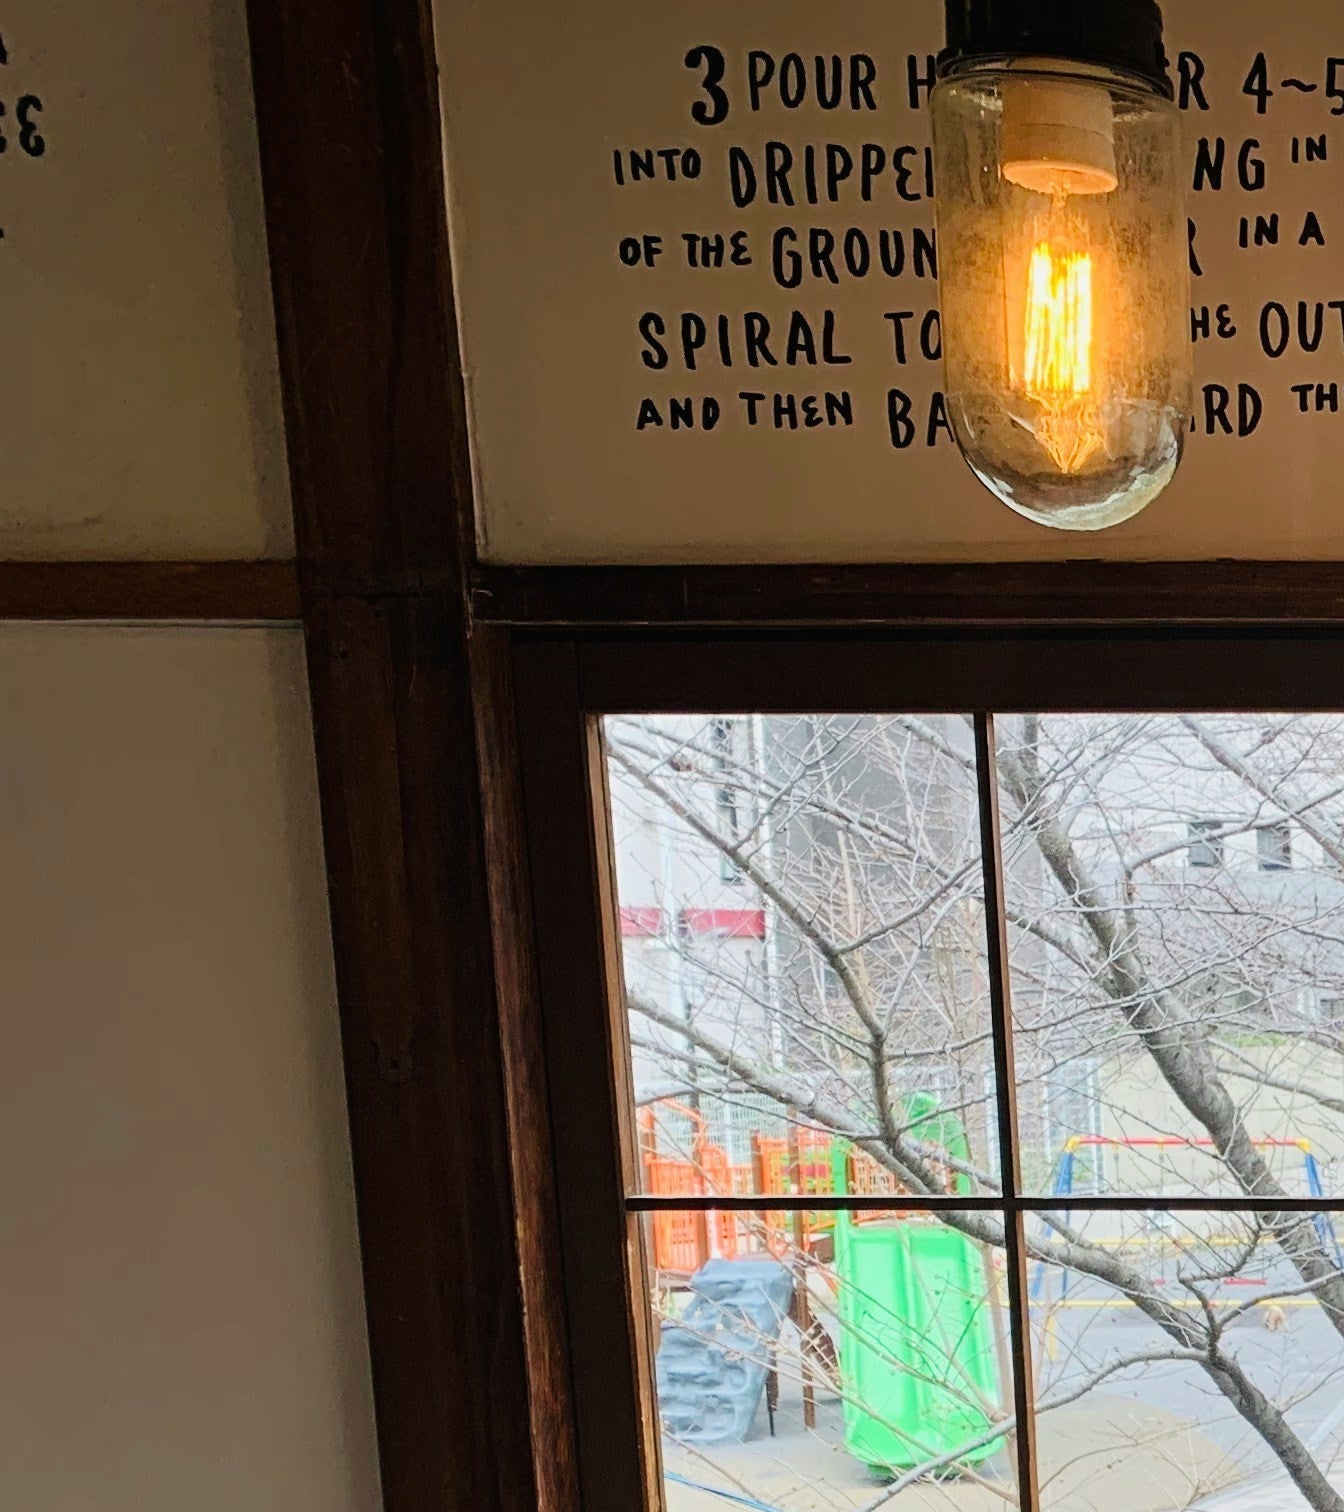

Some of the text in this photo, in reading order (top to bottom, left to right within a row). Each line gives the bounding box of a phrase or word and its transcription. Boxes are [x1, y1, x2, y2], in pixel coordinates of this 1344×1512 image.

[685, 45, 729, 125] 3
[748, 51, 876, 111] POUR
[614, 148, 701, 185] INTO
[729, 142, 934, 208] DRIPPE
[1292, 134, 1326, 163] IN
[620, 235, 662, 267] OF
[682, 231, 752, 267] THE
[773, 227, 937, 288] GROUN
[1239, 214, 1278, 248] IN
[1299, 212, 1325, 246] A
[639, 310, 852, 370] SPIRAL
[1191, 304, 1236, 342] HE
[637, 397, 720, 430] AND
[739, 391, 852, 429] THEN
[888, 389, 956, 448] BA
